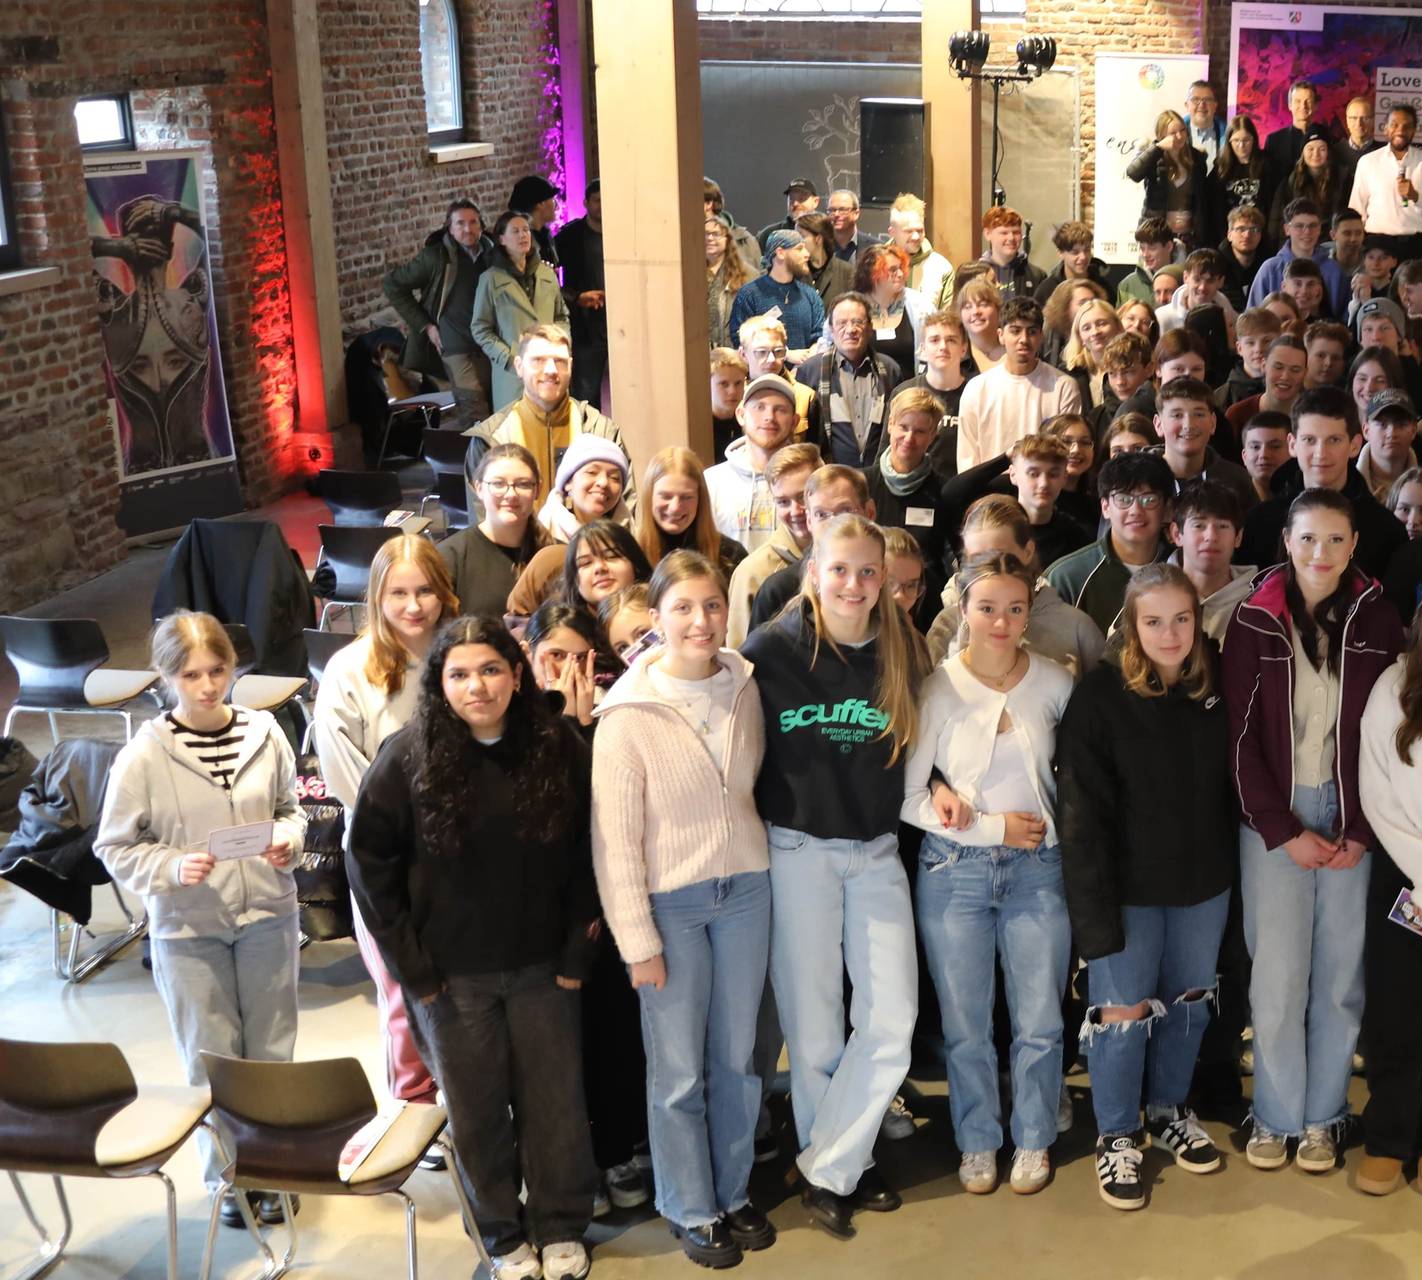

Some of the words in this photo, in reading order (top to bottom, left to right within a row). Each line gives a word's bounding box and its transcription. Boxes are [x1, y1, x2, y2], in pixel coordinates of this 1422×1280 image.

[1381, 72, 1421, 88] Love
[821, 727, 853, 736] EVERYDAY
[853, 729, 874, 737] URBAN
[829, 735, 865, 743] AESTHETICS
